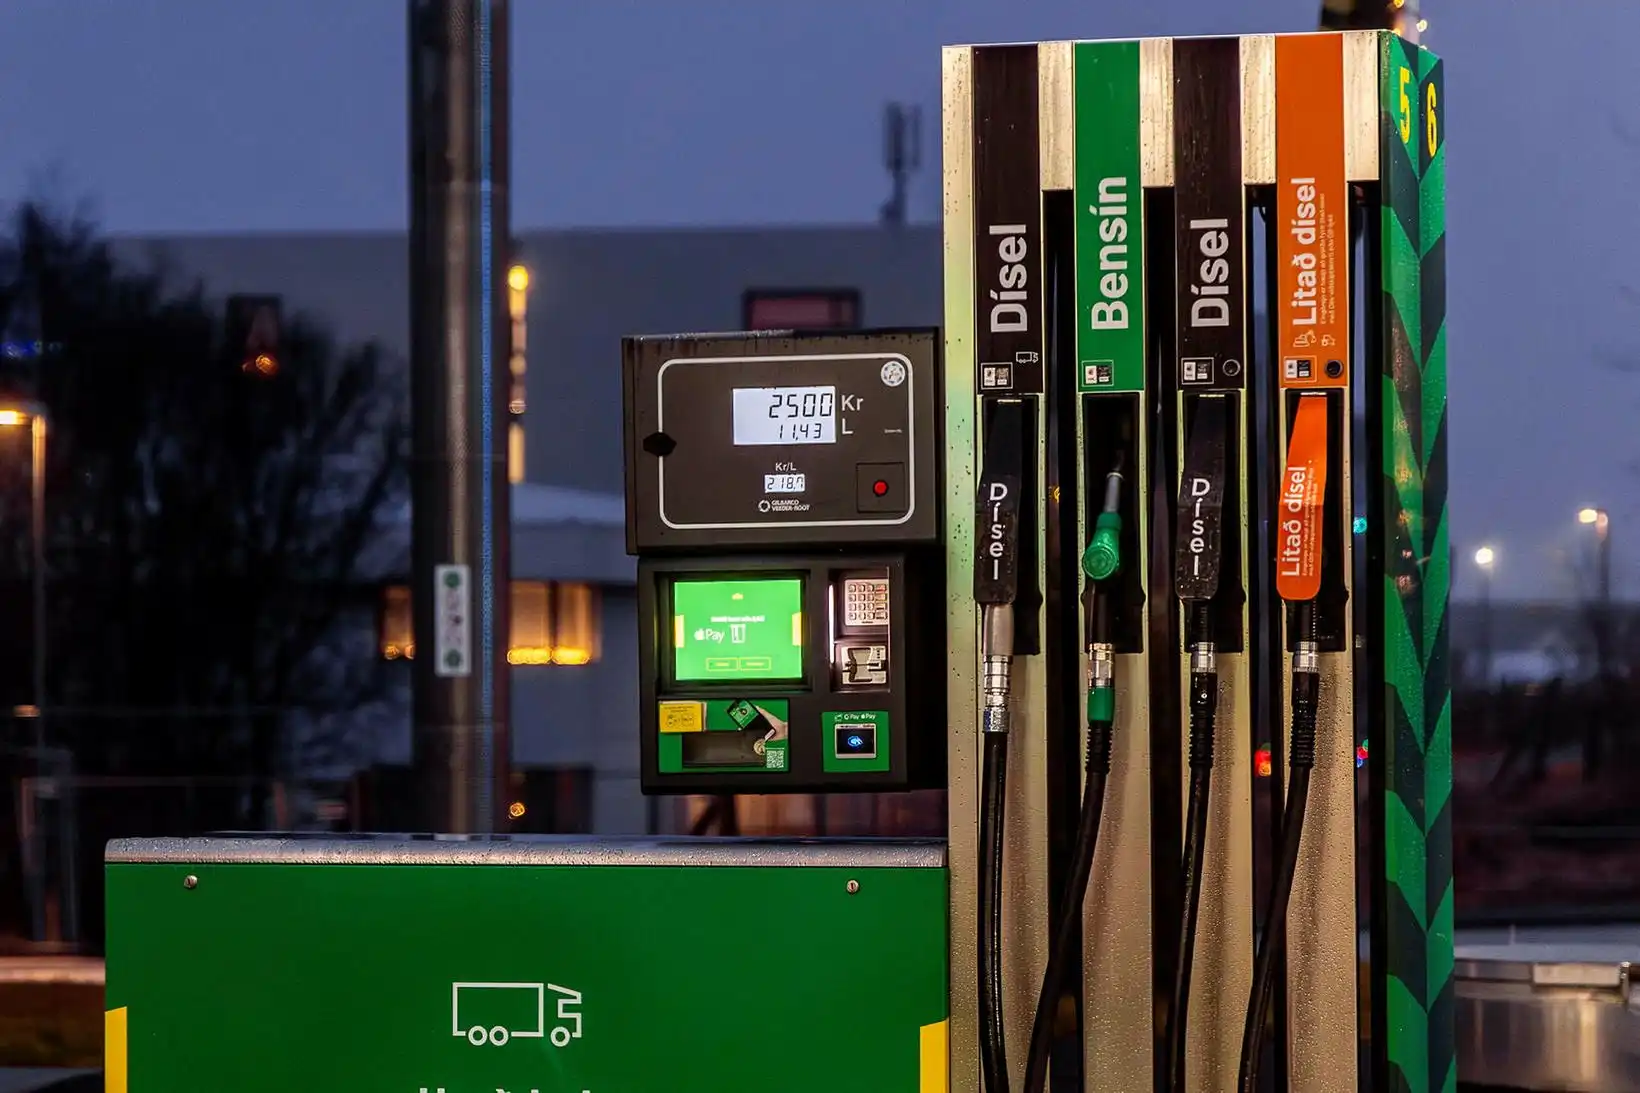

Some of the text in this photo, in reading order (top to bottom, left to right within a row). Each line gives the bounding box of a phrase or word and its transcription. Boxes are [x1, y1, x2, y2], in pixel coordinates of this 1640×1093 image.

[1399, 66, 1411, 144] 5
[1426, 82, 1437, 158] 6
[989, 223, 1028, 333] Dísel
[1089, 176, 1129, 330] Bensín
[1190, 218, 1230, 327] Dísel
[1291, 177, 1317, 325] Litað dísel
[769, 393, 832, 418] 2500
[780, 423, 822, 440] 11,43
[841, 395, 864, 411] Kr
[842, 418, 853, 434] L
[775, 461, 797, 472] Kr/L
[989, 482, 1008, 580] Dísel
[1190, 478, 1210, 576] Dísel
[1281, 466, 1307, 577] Litað dísel
[705, 628, 725, 644] Pay
